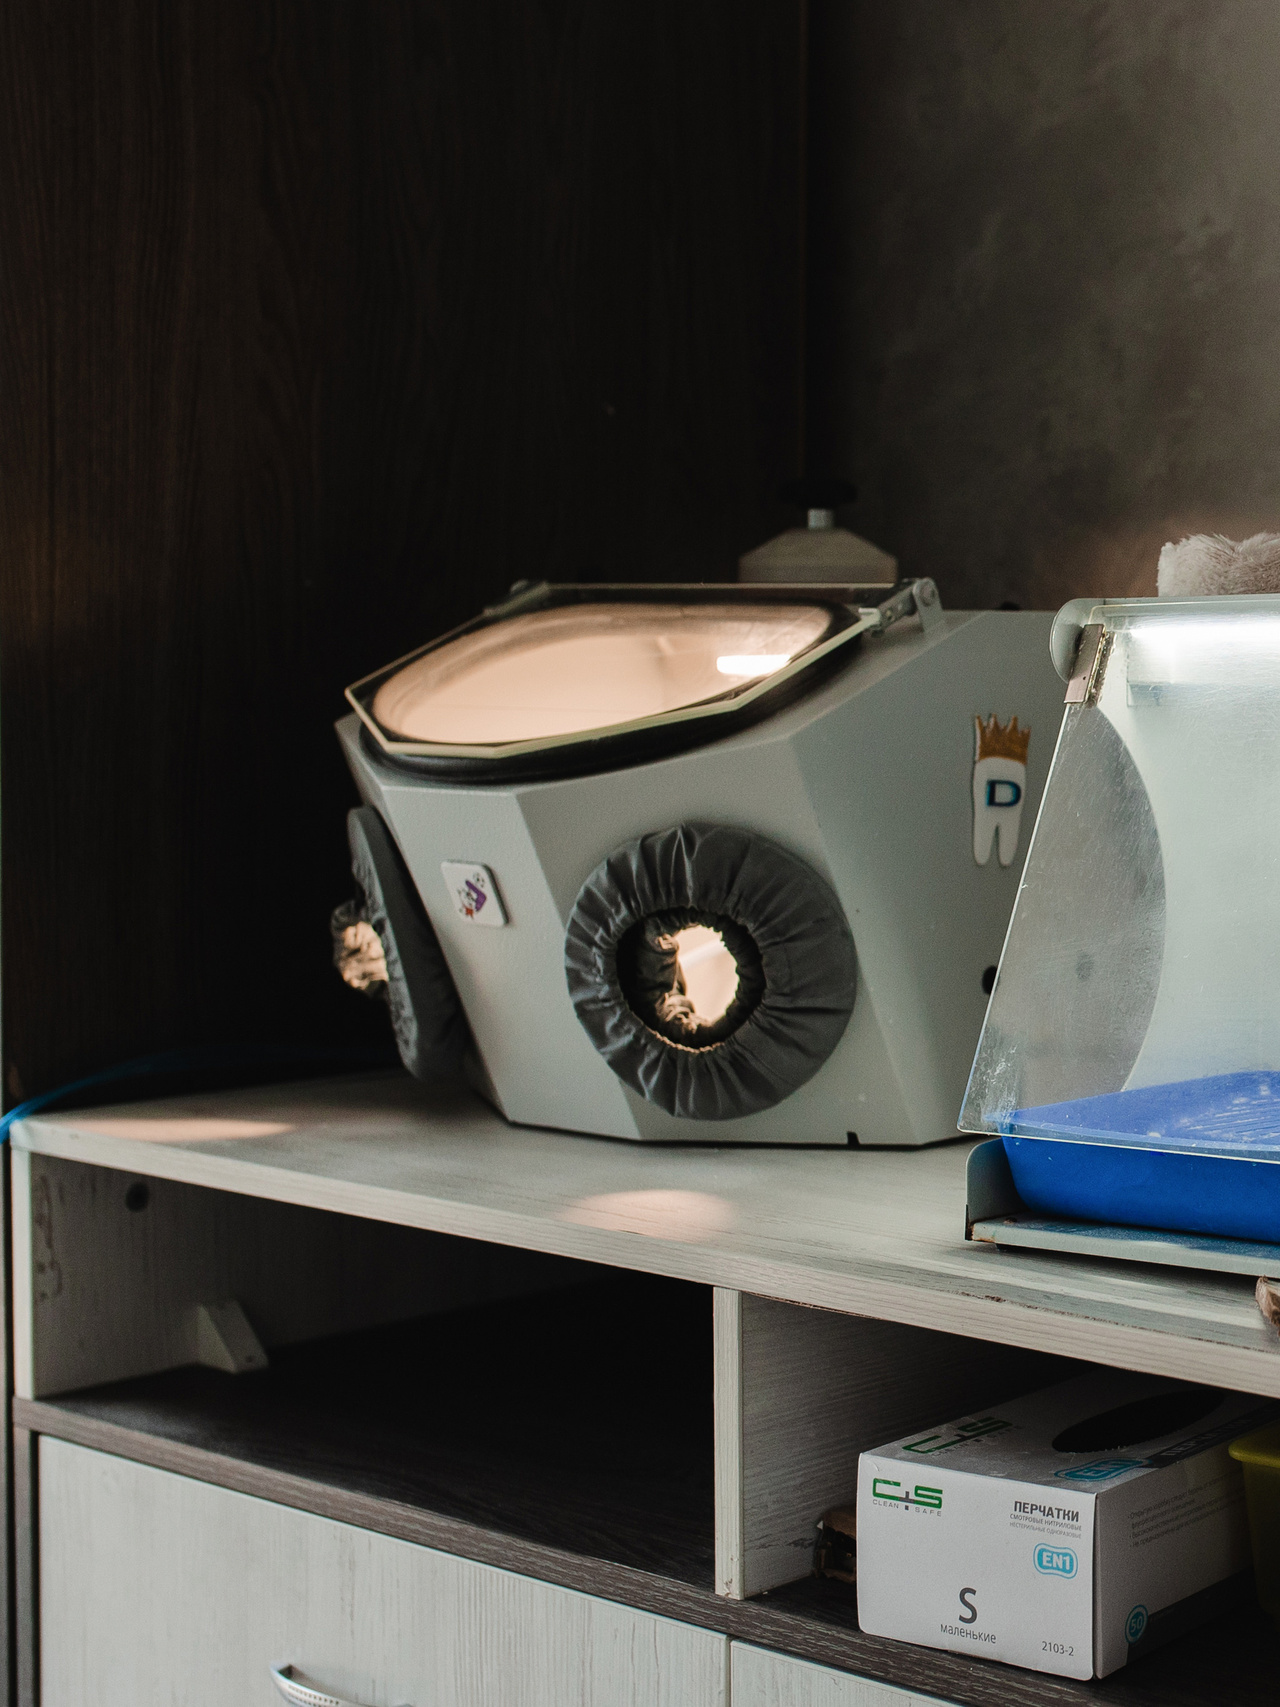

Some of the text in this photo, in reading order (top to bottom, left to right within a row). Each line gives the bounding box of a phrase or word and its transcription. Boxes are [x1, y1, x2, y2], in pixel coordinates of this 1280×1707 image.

[986, 779, 1021, 807] D
[873, 1499, 942, 1517] CLEAN SAFE
[1014, 1500, 1079, 1523] ПЕРЧАТКИ
[1042, 1551, 1071, 1571] EN1
[958, 1587, 978, 1624] S
[940, 1623, 997, 1644] маленькие
[1041, 1640, 1075, 1657] 2103-2
